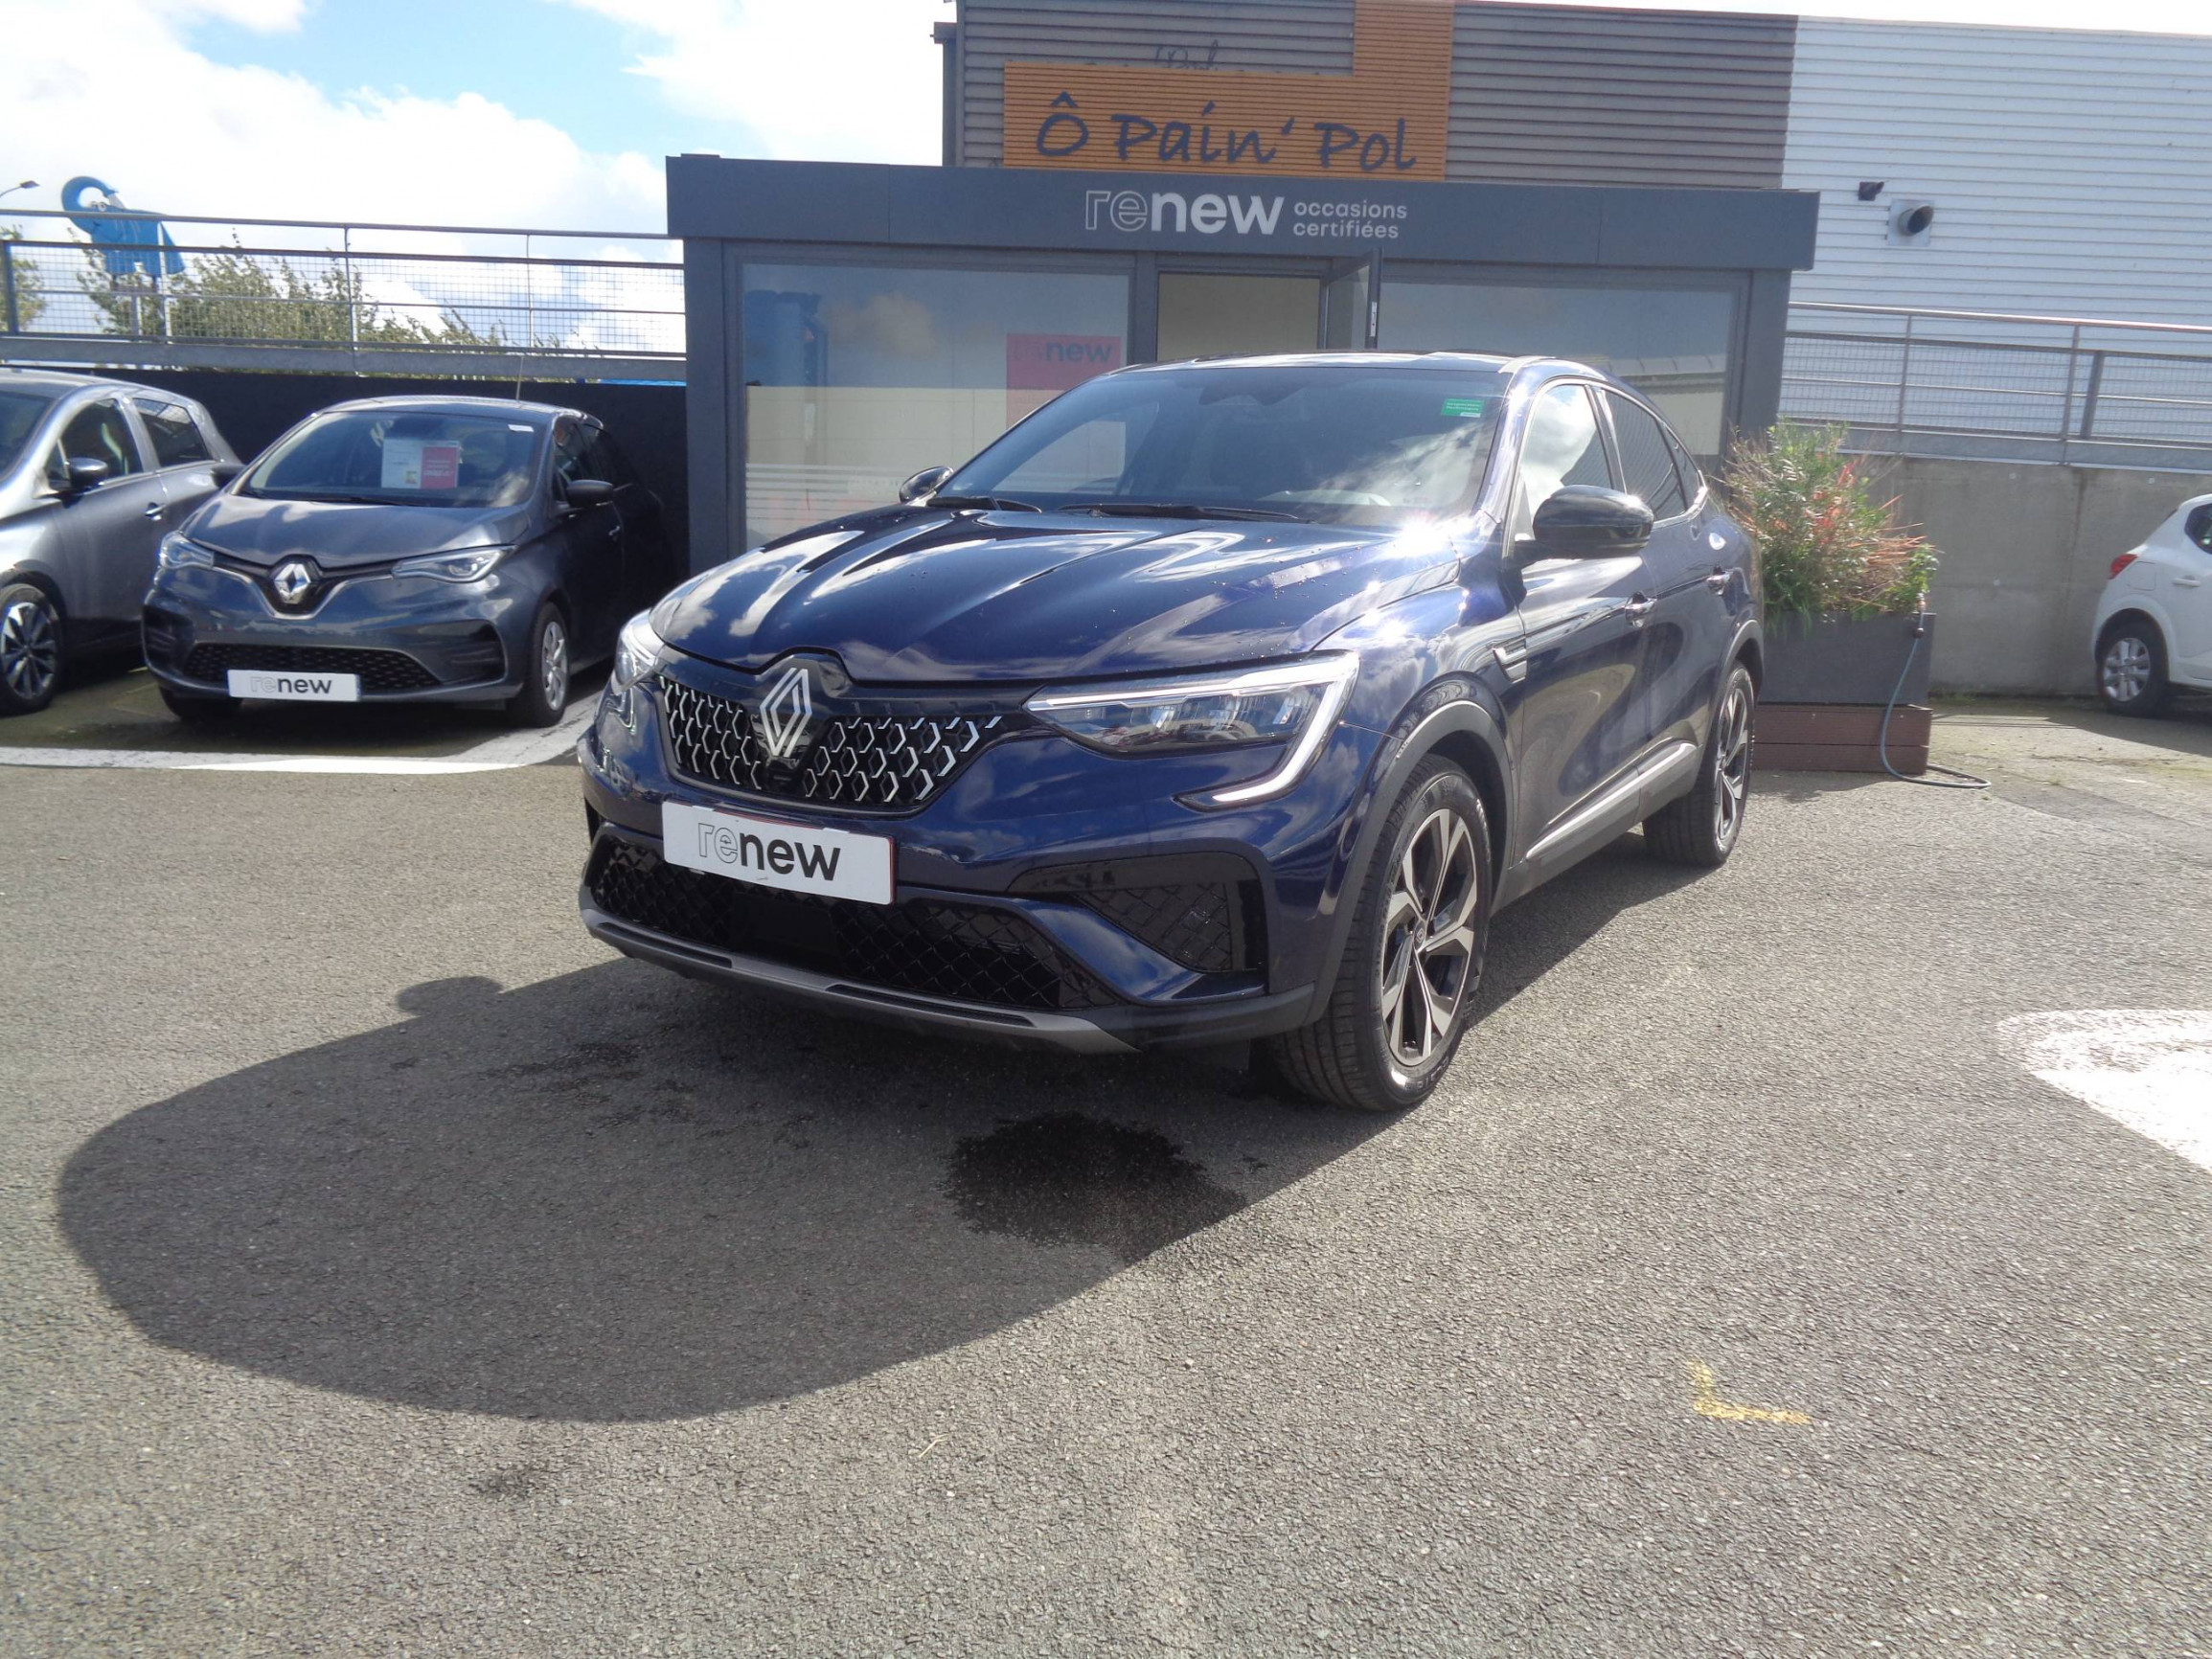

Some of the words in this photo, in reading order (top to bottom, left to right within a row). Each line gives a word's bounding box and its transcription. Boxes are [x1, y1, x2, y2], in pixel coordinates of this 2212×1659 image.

[1037, 91, 1089, 157] Ô
[1313, 117, 1416, 171] Pol
[1085, 190, 1286, 235] renew
[1293, 199, 1407, 219] occasions
[1293, 218, 1399, 239] certifiées
[249, 675, 332, 693] renew
[697, 822, 841, 881] renew
